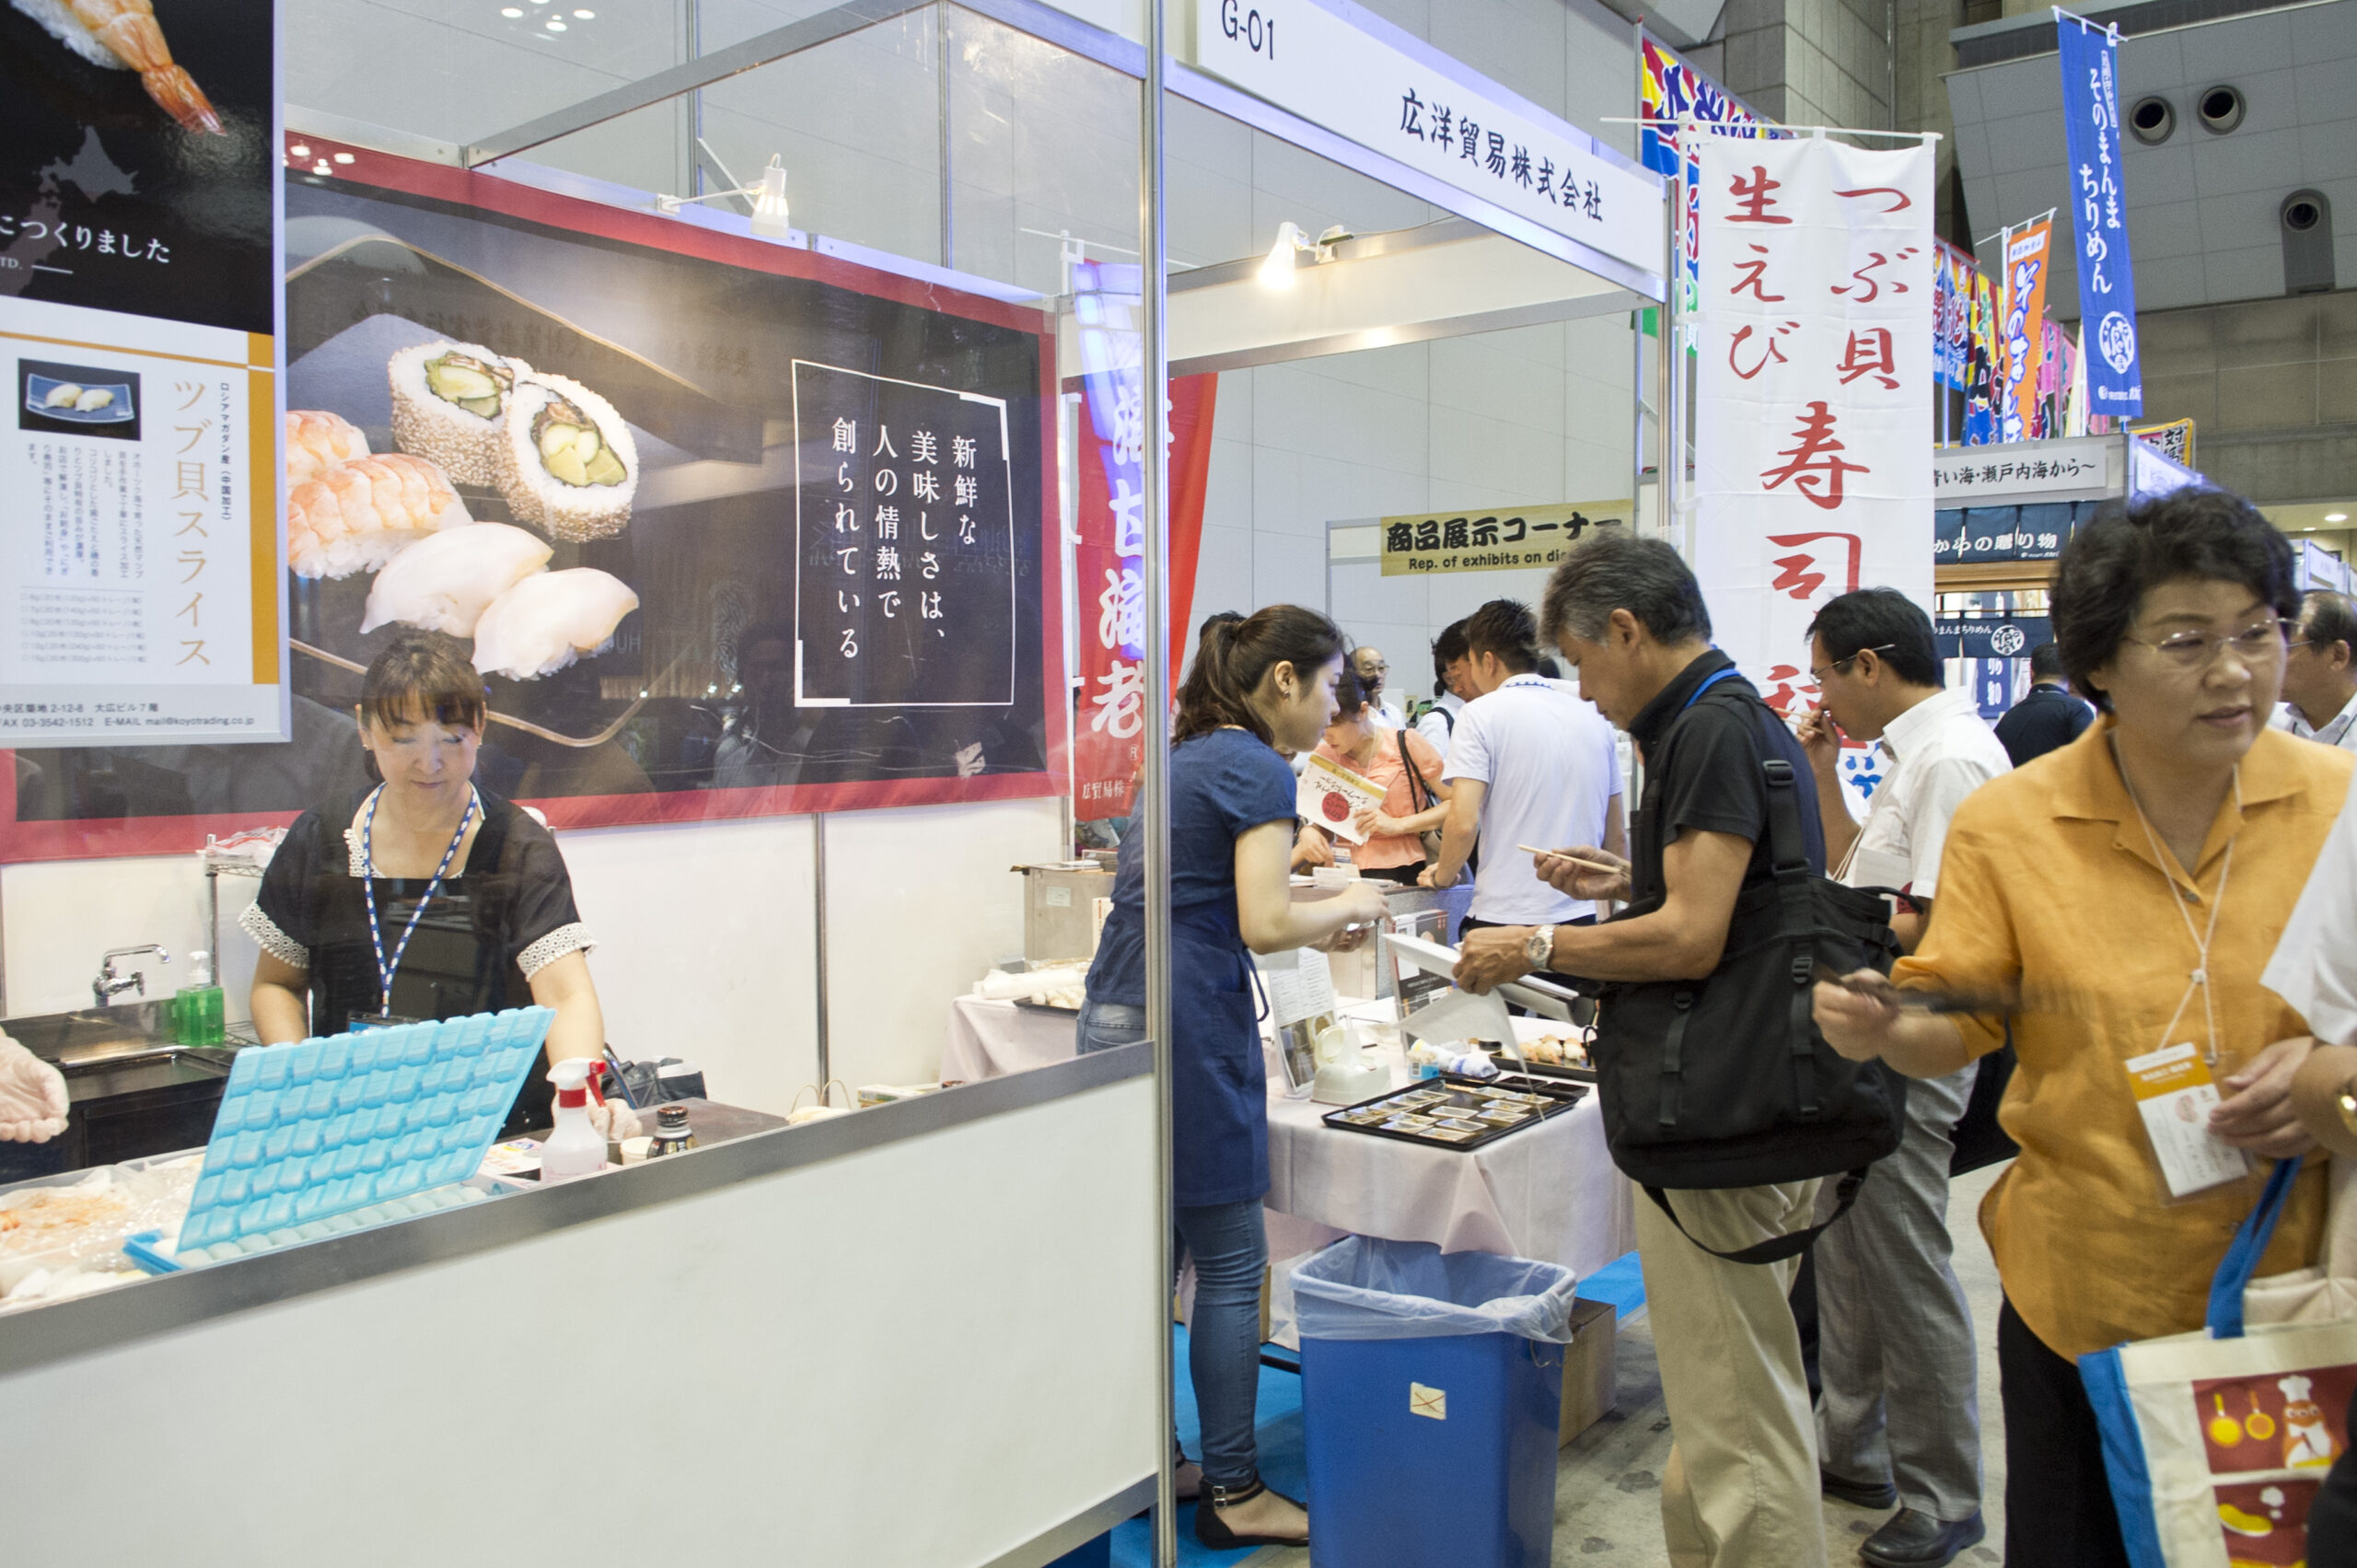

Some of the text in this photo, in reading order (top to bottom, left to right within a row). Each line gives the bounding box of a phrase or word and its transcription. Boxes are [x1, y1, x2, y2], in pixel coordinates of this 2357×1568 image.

[1221, 0, 1274, 60] G-01
[1399, 87, 1604, 222] 広洋貿易株式会社
[2090, 68, 2121, 229] そのまんま
[1724, 166, 1801, 379] 生えび
[1830, 187, 1920, 390] つぶ貝
[2079, 163, 2113, 295] ちりめん
[170, 381, 213, 667] ツブ貝スライス
[832, 416, 861, 658] 創られている
[873, 424, 901, 619] 人の情熱で
[911, 430, 946, 637] 美味しさは、
[952, 436, 979, 545] 新鮮な
[1387, 511, 1622, 552] 商品展示コーナー
[1409, 557, 1438, 571] Rep.
[1443, 557, 1457, 568] of
[1462, 552, 1519, 567] exhibits
[1524, 553, 1541, 564] on
[105, 717, 141, 726] E-MAIL
